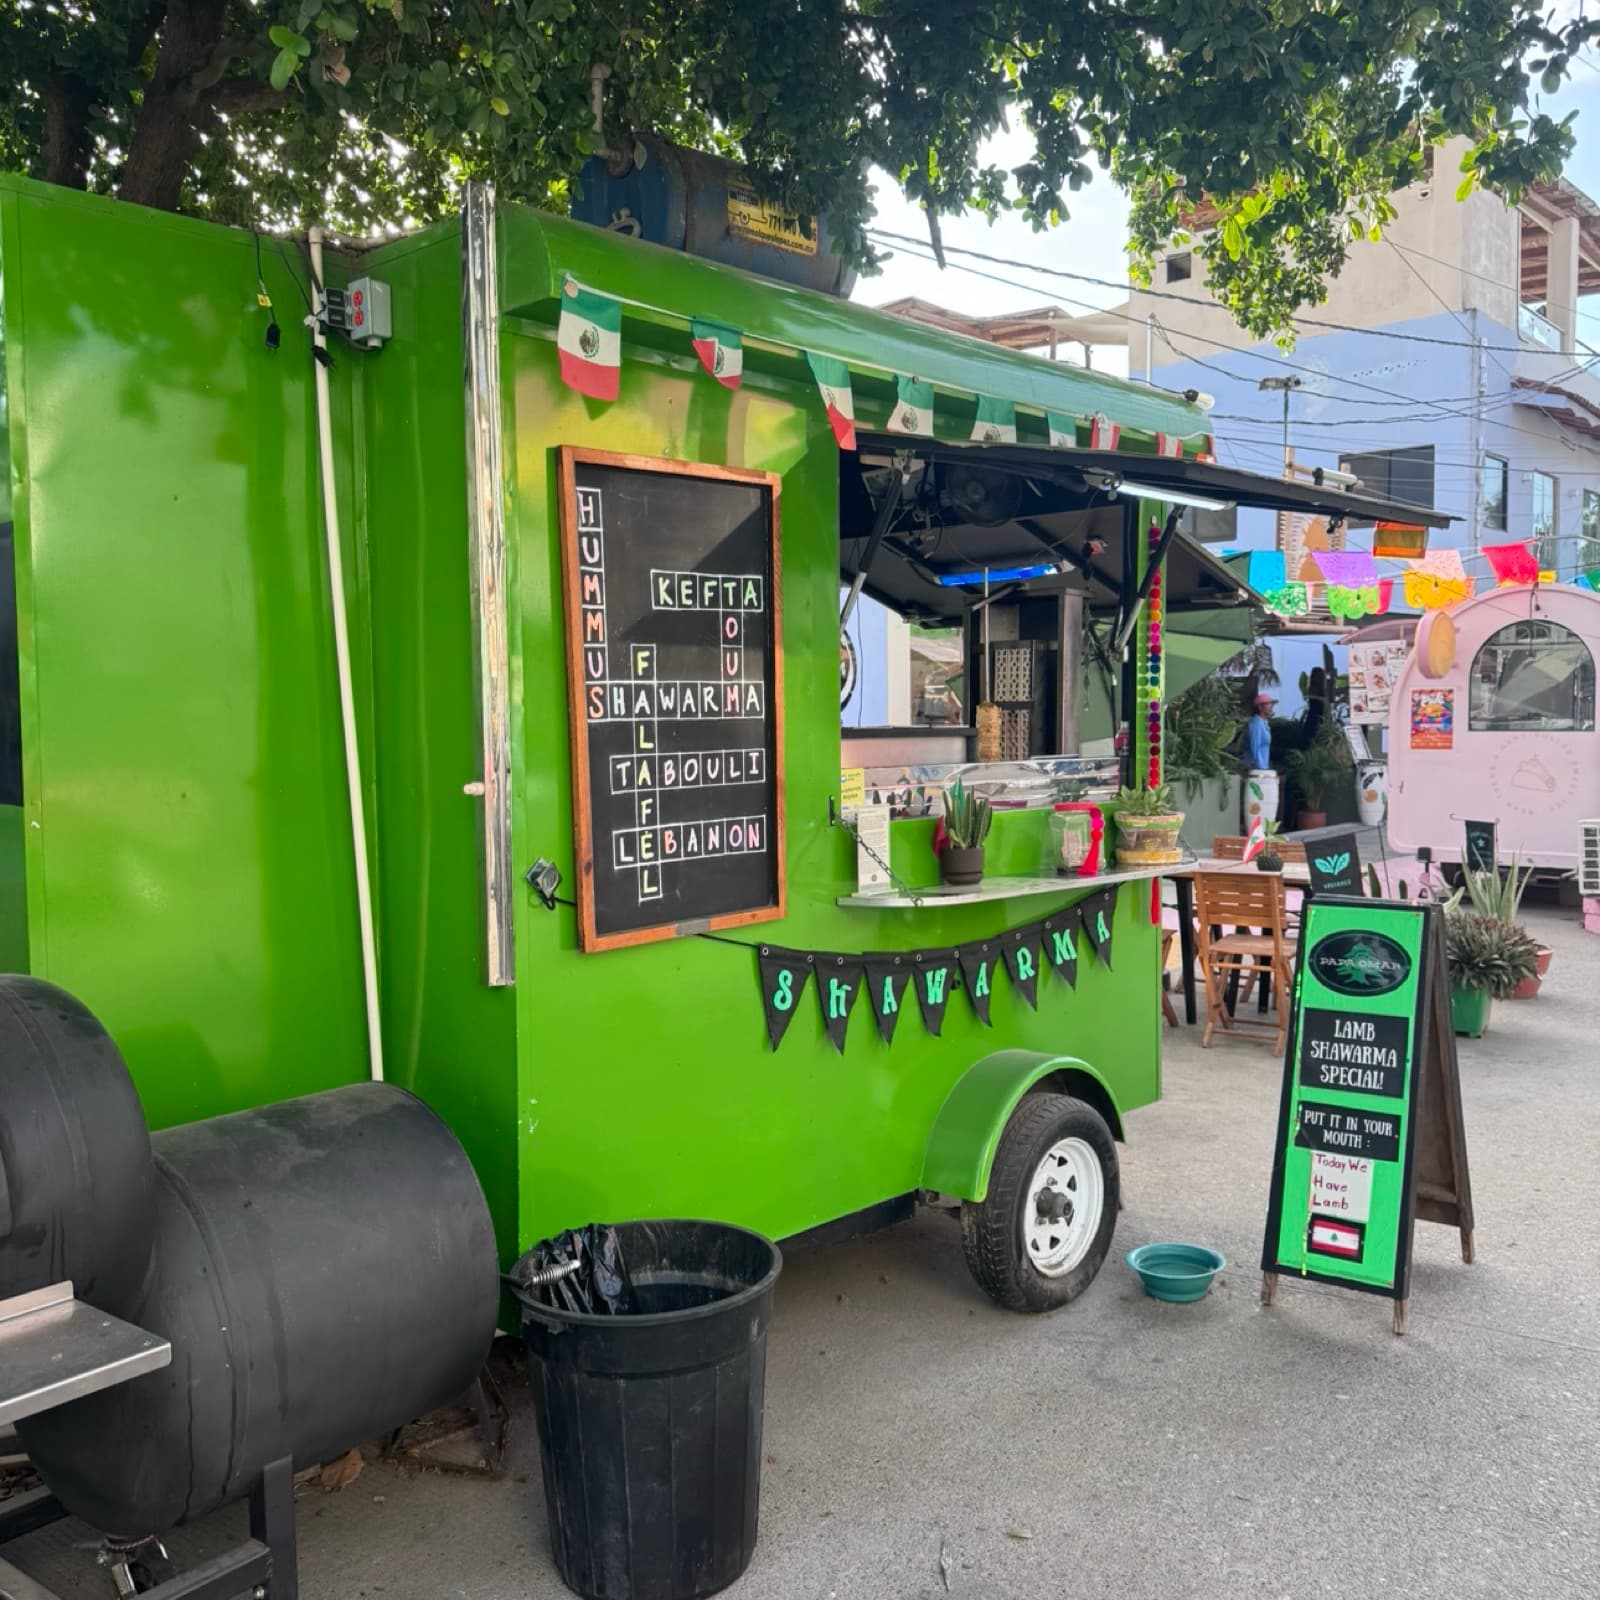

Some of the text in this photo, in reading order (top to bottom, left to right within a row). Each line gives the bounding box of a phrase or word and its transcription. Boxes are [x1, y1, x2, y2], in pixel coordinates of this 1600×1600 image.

[657, 576, 758, 608] KEFTA
[578, 494, 606, 719] HUMMUS
[723, 581, 740, 712] TOUM
[588, 685, 761, 719] SHAWARMA
[615, 750, 761, 787] TABOULI
[635, 650, 658, 895] FALAFEL
[619, 824, 760, 862] LEBANON
[1320, 957, 1354, 968] PAPA
[1333, 1019, 1376, 1042] LAMB
[1310, 1040, 1398, 1068] SHAWARMA
[1320, 1064, 1384, 1090] SPECIAL!
[1304, 1109, 1393, 1137] PUT IT IN YOUR
[1322, 1129, 1363, 1149] MOUTH
[1315, 1153, 1368, 1174] Today We
[1314, 1174, 1348, 1192] Have
[1312, 1194, 1349, 1210] Lamb
